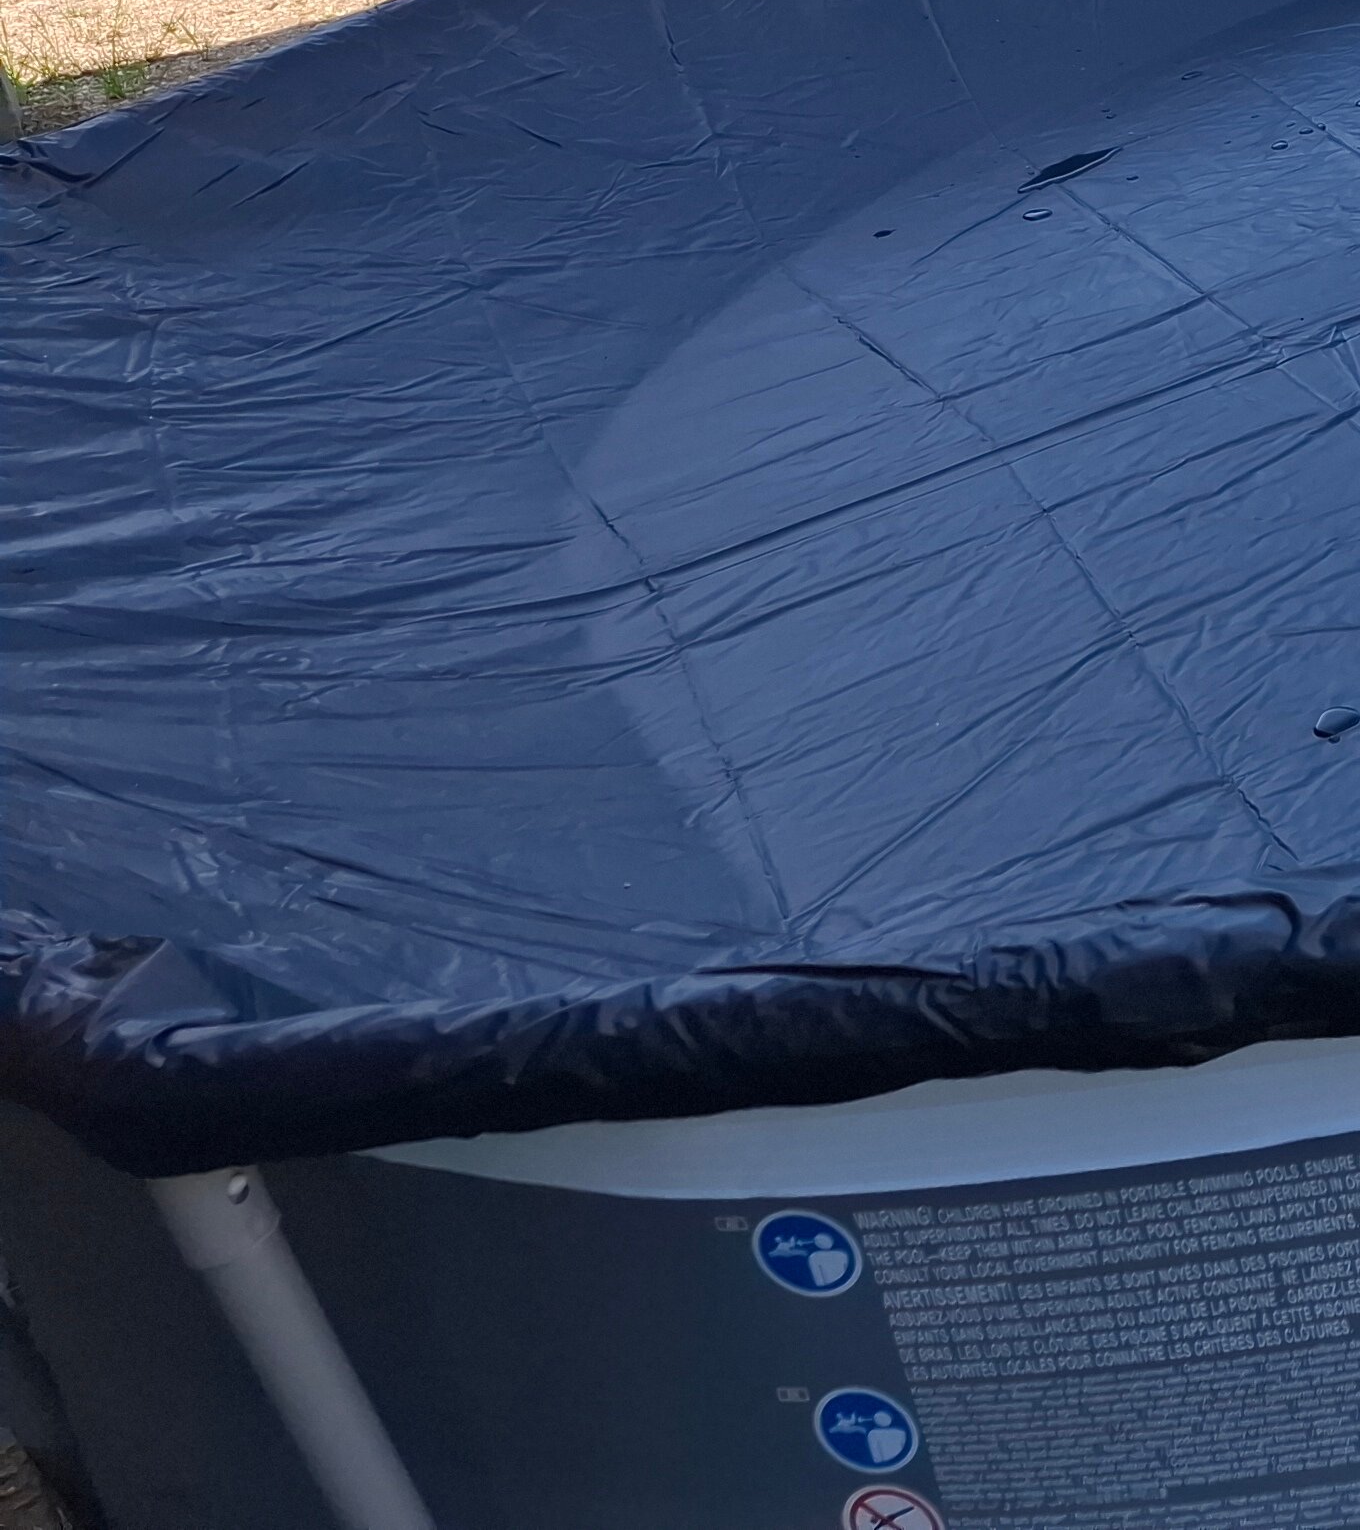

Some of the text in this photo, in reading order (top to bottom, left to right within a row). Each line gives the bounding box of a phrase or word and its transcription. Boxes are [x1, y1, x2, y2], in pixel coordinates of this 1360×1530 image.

[861, 1231, 900, 1246] ADULT
[903, 1224, 985, 1243] SUPERVISION
[987, 1222, 1003, 1237] AT
[1005, 1220, 1029, 1235] ALL
[1075, 1213, 1093, 1228] DO
[1096, 1210, 1122, 1225] NOT
[1125, 1204, 1164, 1222] LEAVE
[1167, 1195, 1229, 1217] CHILDREN
[1233, 1180, 1326, 1208] UNSUPERVISED
[1329, 1177, 1342, 1192] IN
[936, 1204, 1000, 1222] CHILDREN
[1002, 1200, 1036, 1216] HAVE
[1038, 1193, 1102, 1212] DROWNED
[1103, 1191, 1118, 1205] IN
[1119, 1182, 1185, 1203] PORTABLE
[1304, 1155, 1355, 1176] ENSURE
[867, 1251, 891, 1264] THE
[975, 1241, 1008, 1257] THEM
[1147, 1222, 1180, 1239] POOL
[1183, 1214, 1237, 1234] FENCING
[1240, 1208, 1276, 1226] LAWS
[1278, 1202, 1317, 1220] APPLY
[1319, 1198, 1337, 1214] TO
[873, 1267, 930, 1283] CONSULT
[934, 1264, 966, 1279] YOUR
[969, 1260, 1010, 1276] LOCAL
[1012, 1251, 1099, 1273] GOVERNMENT
[1101, 1243, 1172, 1264] AUTHORITY
[1173, 1239, 1199, 1255] FOR
[1202, 1231, 1256, 1251] FENCING
[1017, 1283, 1042, 1298] DES
[1045, 1277, 1100, 1296] ENFANTS
[1103, 1275, 1120, 1290] SE
[1122, 1270, 1156, 1288] SONT
[1203, 1260, 1238, 1278] DANS
[1241, 1256, 1266, 1272] DES
[1267, 1246, 1324, 1268] PISCINES
[1023, 1296, 1107, 1316] SUPERVISION
[1106, 1290, 1154, 1308] ADULTE
[1156, 1285, 1200, 1303] ACTIVE
[1281, 1270, 1298, 1286] NE
[1302, 1261, 1353, 1282] LAISSEZ
[894, 1328, 947, 1344] ENFANTS
[951, 1326, 983, 1341] SANS
[986, 1318, 1077, 1338] SURVEILLANCE
[1080, 1314, 1113, 1330] DANS
[1116, 1312, 1134, 1326] OU
[1136, 1305, 1188, 1324] AUTOUR
[1191, 1303, 1208, 1318] DE
[1210, 1300, 1226, 1315] LA
[1228, 1293, 1277, 1313] PISCINE
[899, 1349, 915, 1362] DE
[957, 1345, 980, 1359] LES
[1013, 1342, 1029, 1355] DE
[1092, 1333, 1117, 1348] DES
[1119, 1327, 1168, 1345] PISCINE
[1272, 1308, 1312, 1326] CETTE
[904, 1366, 928, 1380] LES
[998, 1358, 1055, 1375] LOCALES
[1058, 1354, 1092, 1370] POUR
[1167, 1343, 1191, 1359] LES
[1256, 1331, 1281, 1348] DES
